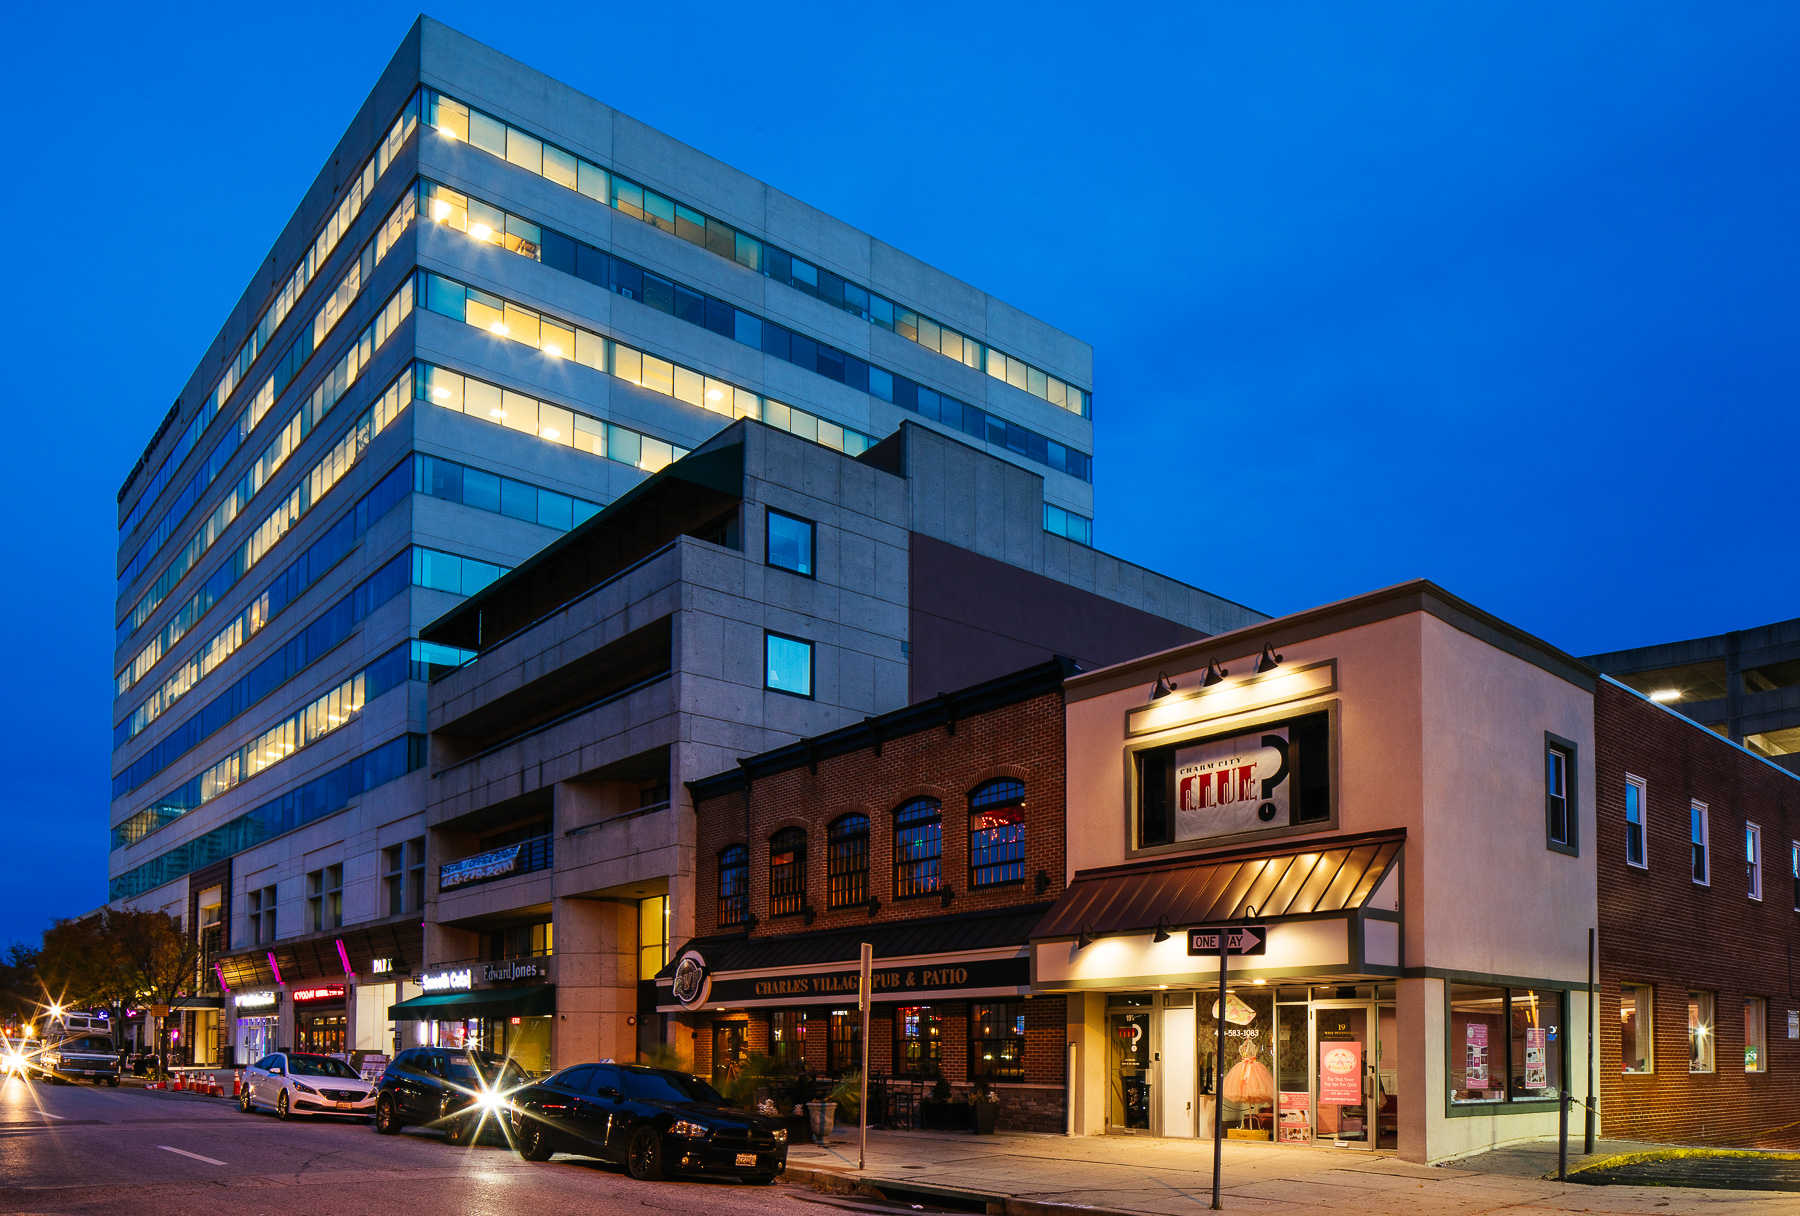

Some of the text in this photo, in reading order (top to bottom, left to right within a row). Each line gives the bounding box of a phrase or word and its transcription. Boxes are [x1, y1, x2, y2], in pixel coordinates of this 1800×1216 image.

[1180, 757, 1241, 775] CHARM CITY
[1195, 935, 1243, 948] ONE AY
[483, 962, 537, 981] Edward Jones
[755, 967, 968, 995] CHARLES VILLAG PUB & PATIO
[1214, 1029, 1259, 1037] 4-583-1083
[1338, 1023, 1346, 1031] 19
